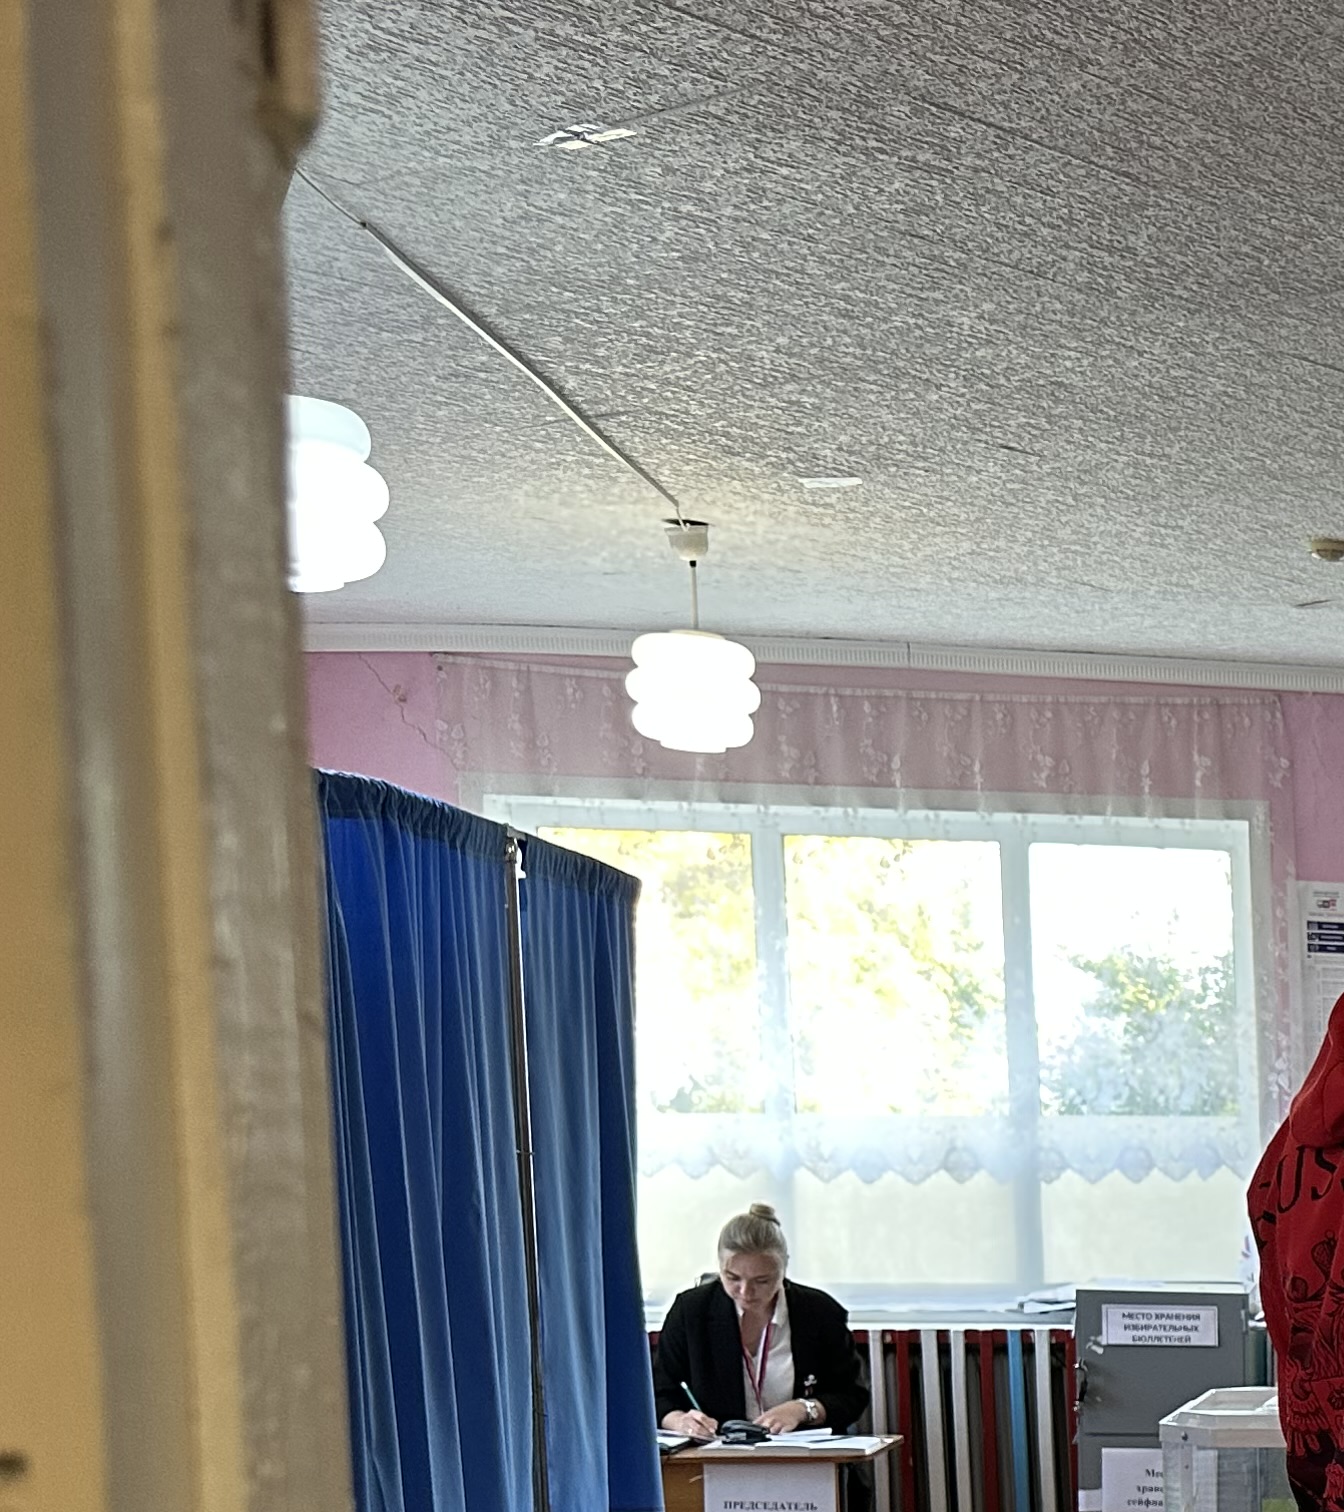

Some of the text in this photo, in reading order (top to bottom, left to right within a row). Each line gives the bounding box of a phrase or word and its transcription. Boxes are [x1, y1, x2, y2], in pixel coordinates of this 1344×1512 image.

[1122, 1312, 1200, 1321] МЕСТО ХРАНЕНИЯ
[1123, 1324, 1199, 1332] ИЗБИРАТЕЛЬНЫХ
[1132, 1335, 1191, 1343] БЮЛЛЕТЕНЕЙ
[723, 1501, 818, 1511] ПРЕДСЕДАТЕЛЬ
